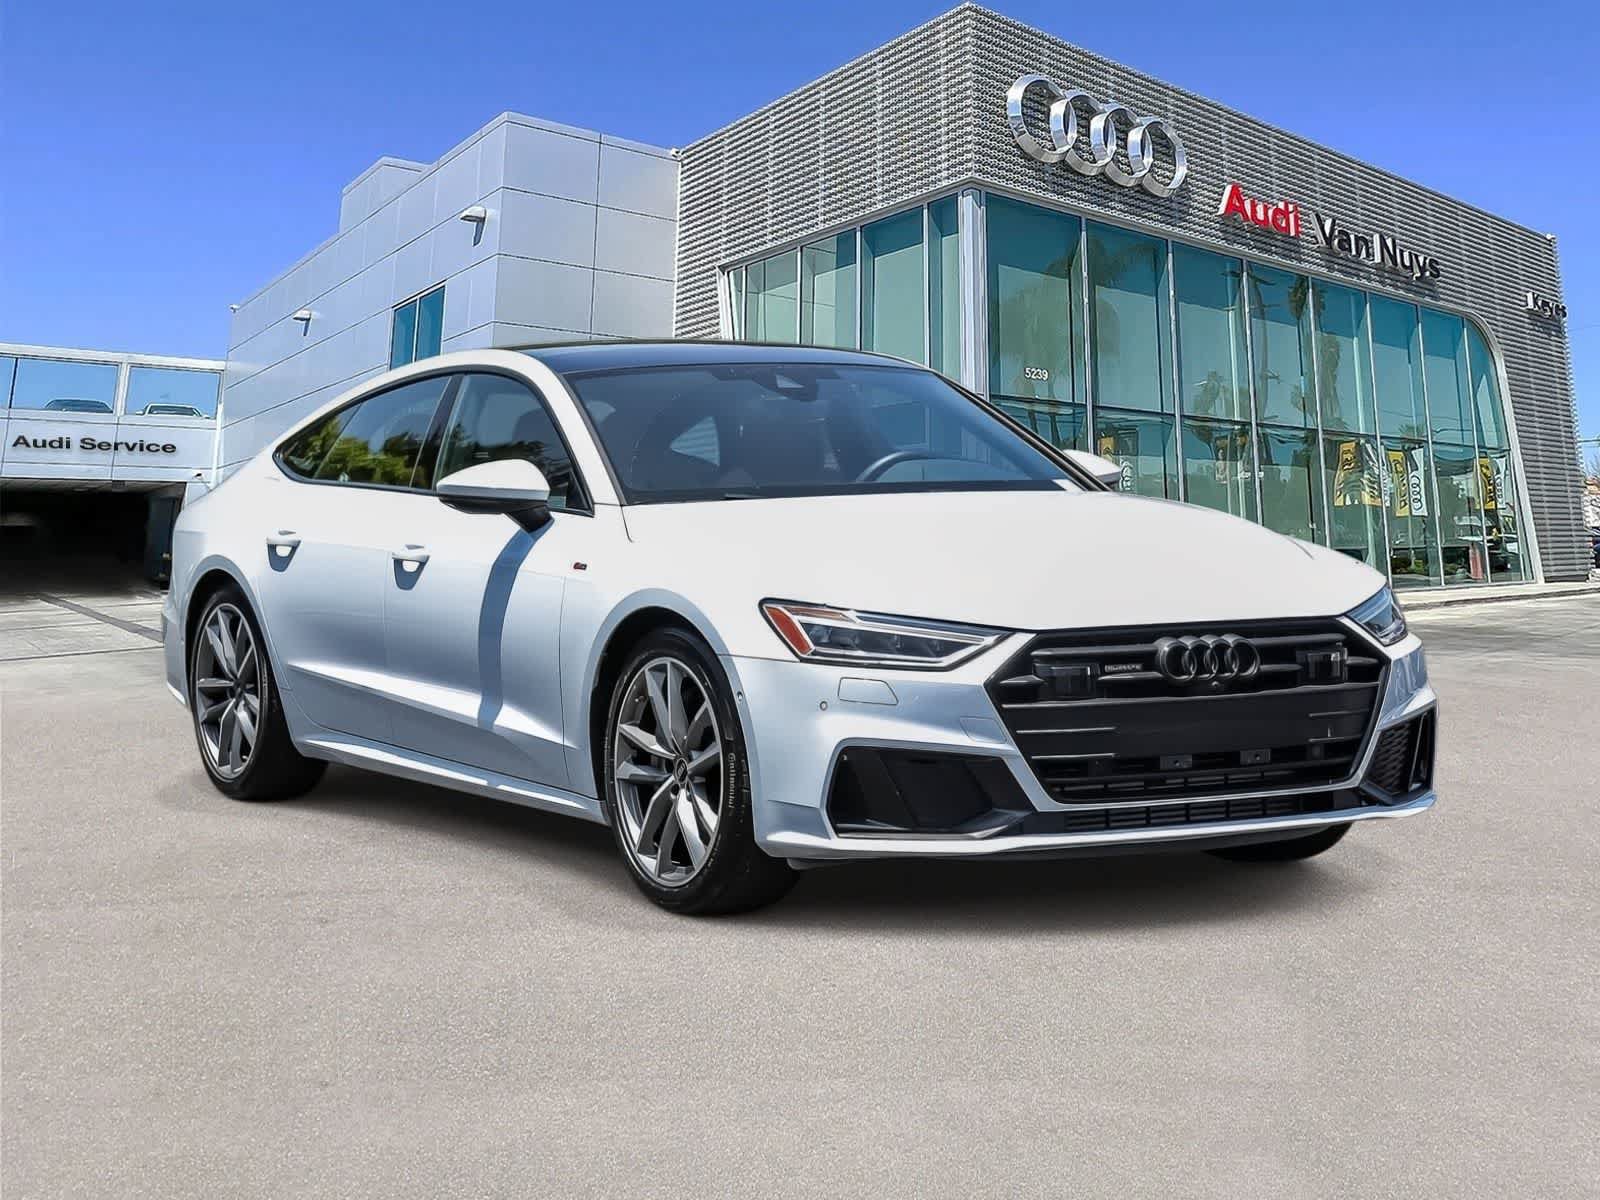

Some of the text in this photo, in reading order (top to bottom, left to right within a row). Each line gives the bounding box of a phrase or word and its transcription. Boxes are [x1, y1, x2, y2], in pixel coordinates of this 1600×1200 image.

[1217, 182, 1442, 281] Audi Van Nuys
[1024, 367, 1049, 381] 5239
[12, 435, 177, 454] Audi Service
